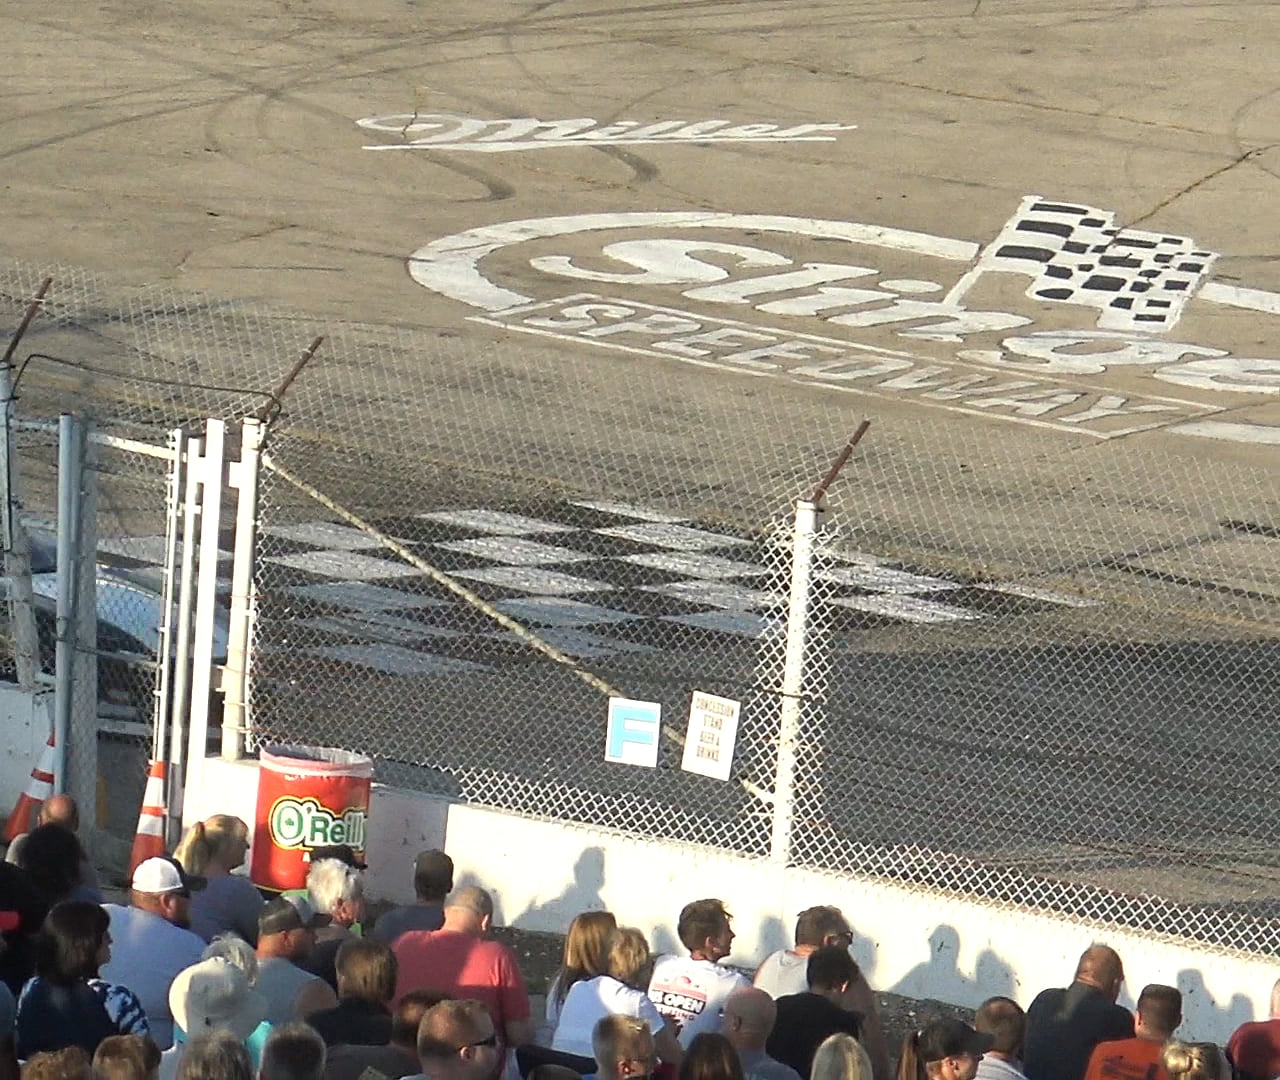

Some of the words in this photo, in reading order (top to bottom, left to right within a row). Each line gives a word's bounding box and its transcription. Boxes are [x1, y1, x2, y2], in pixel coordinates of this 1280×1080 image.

[524, 302, 1182, 423] SPEEDWAY
[529, 238, 1280, 396] Slinge
[609, 704, 658, 758] F
